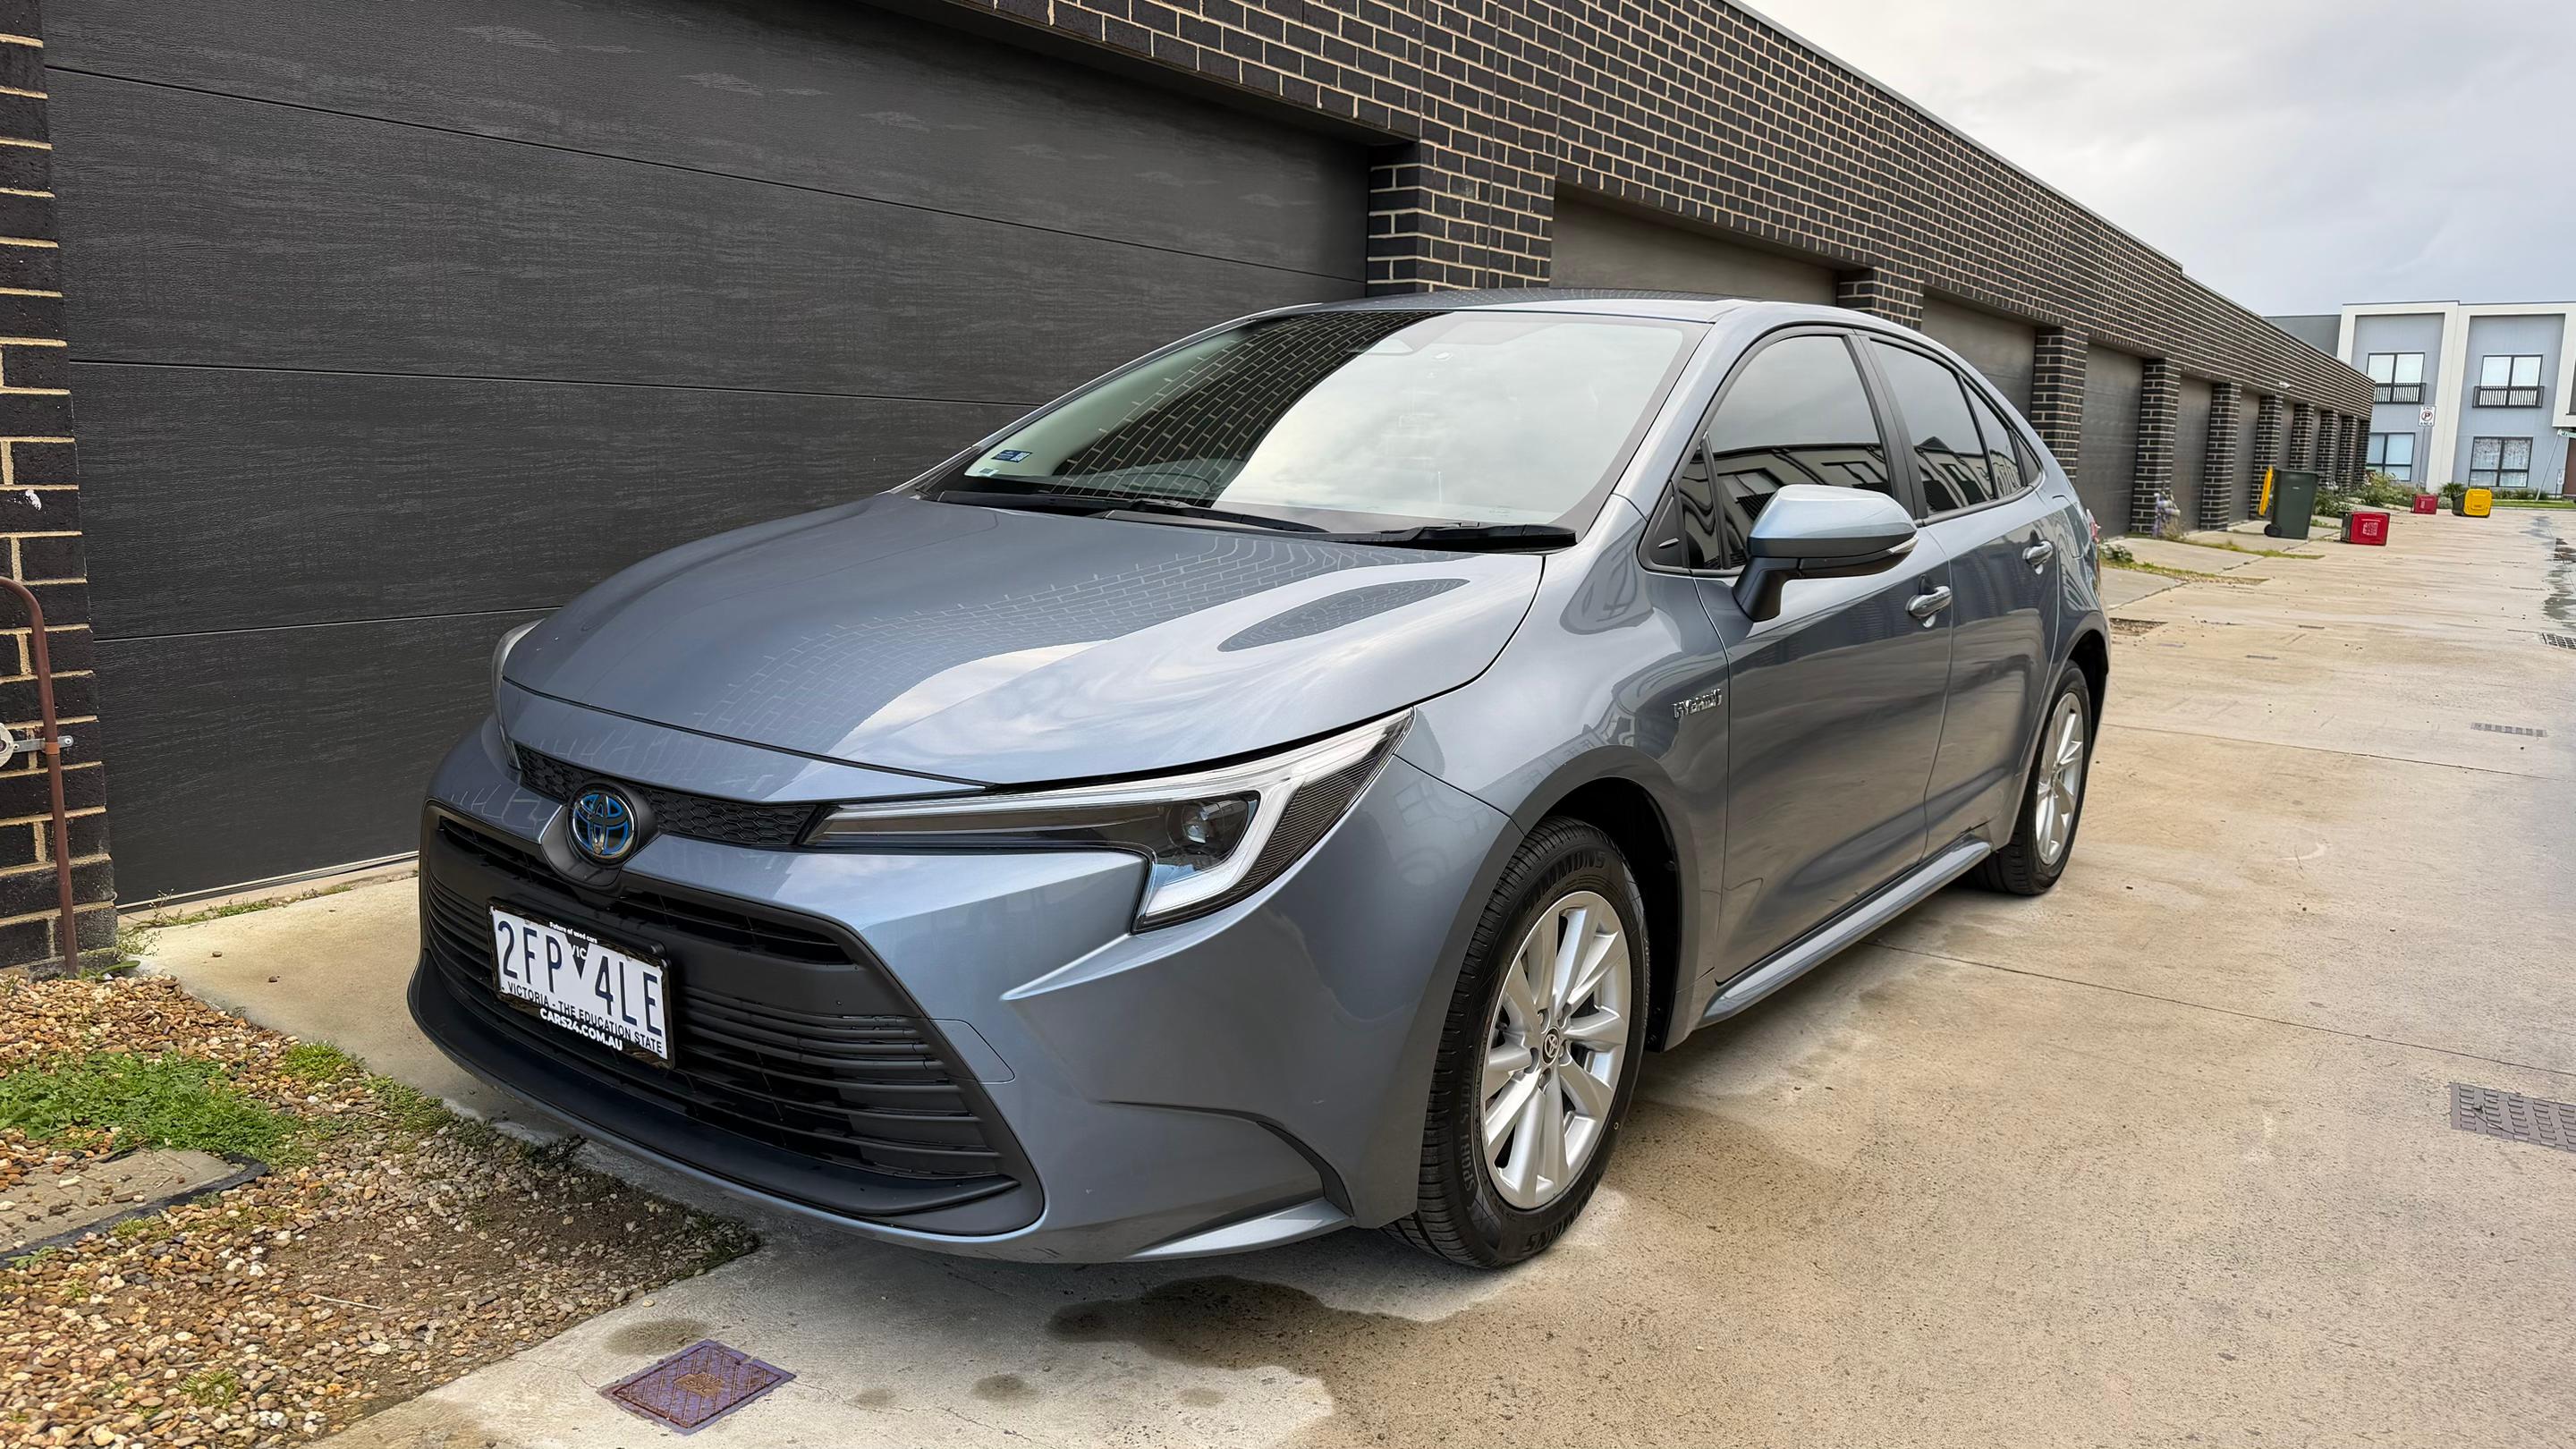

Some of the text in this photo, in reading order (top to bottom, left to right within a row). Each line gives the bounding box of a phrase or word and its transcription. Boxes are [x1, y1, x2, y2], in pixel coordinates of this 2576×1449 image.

[497, 920, 662, 1038] 2FP 4LE
[508, 981, 549, 1008] VICTORIA
[558, 1000, 576, 1016] THE
[579, 1009, 631, 1041] EDUCATION
[634, 1031, 662, 1054] STATE
[539, 1007, 623, 1051] CARS24.COM.AU
